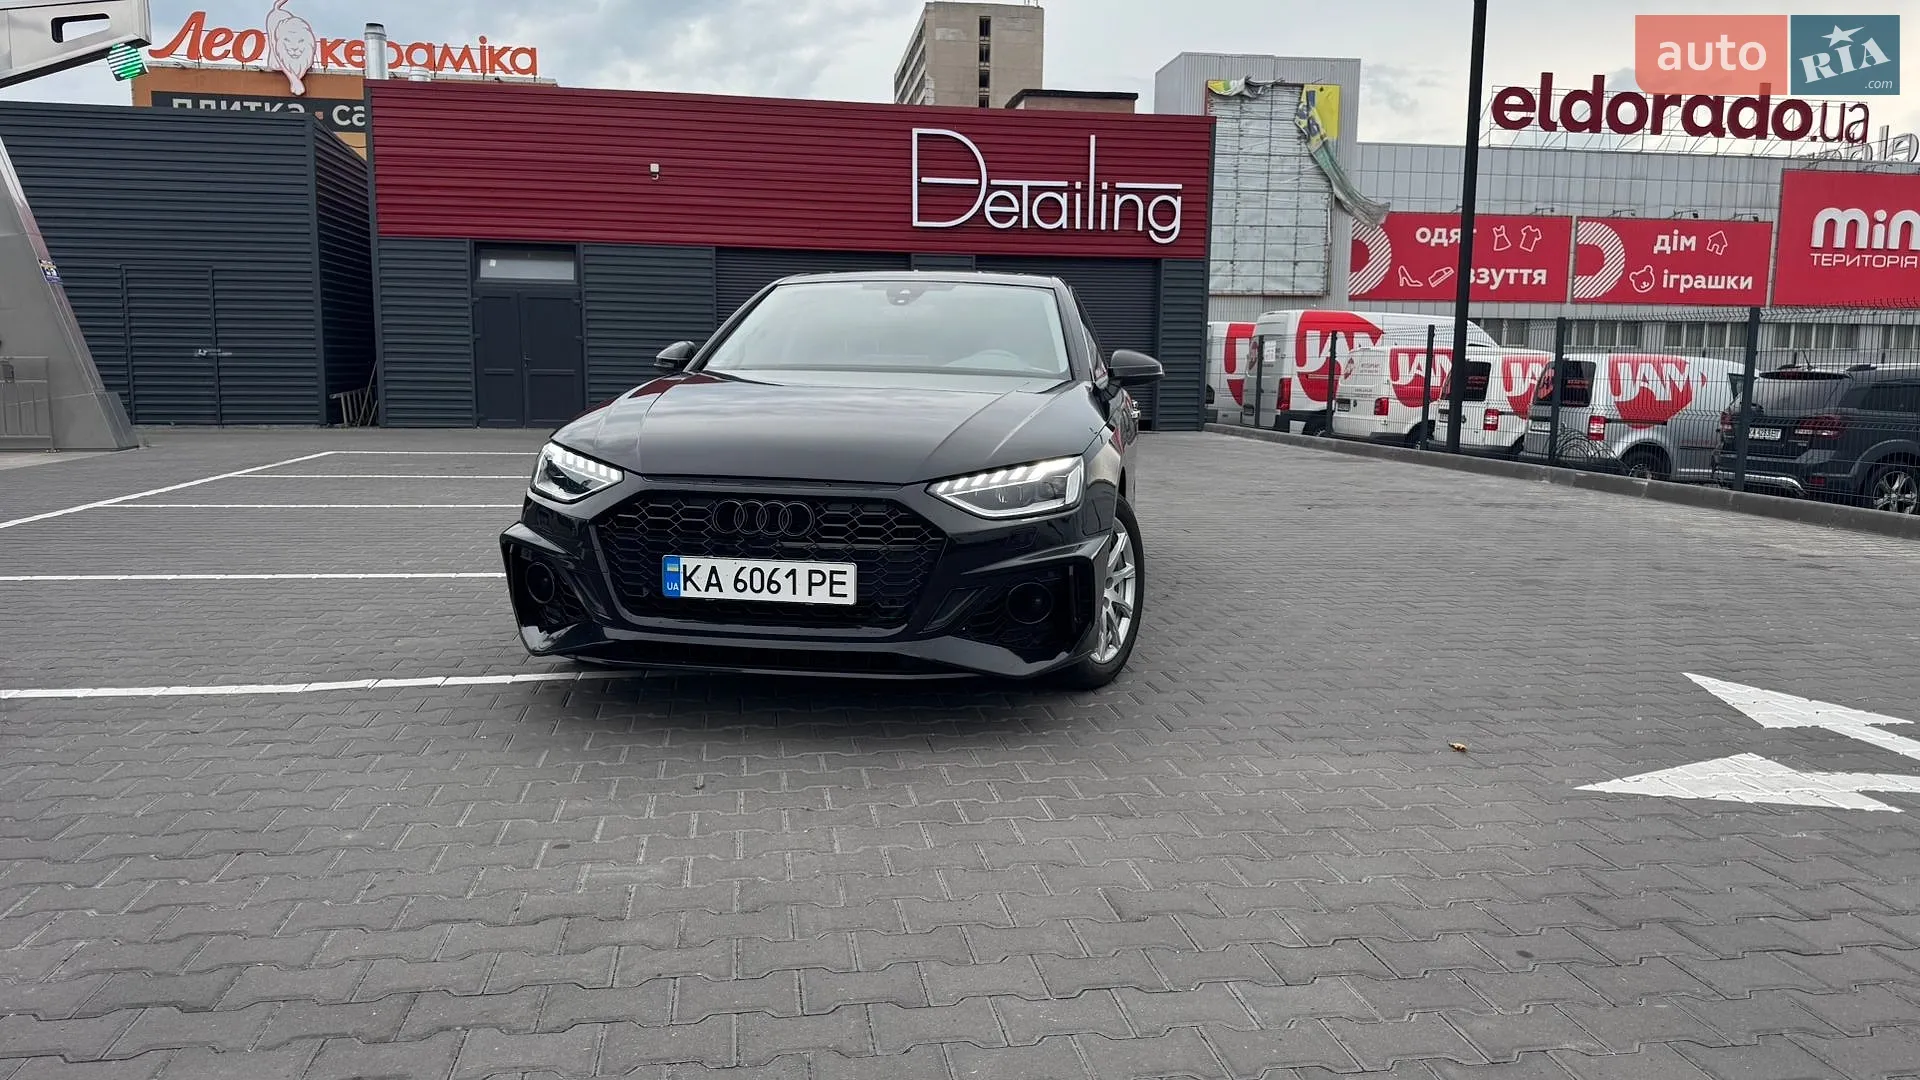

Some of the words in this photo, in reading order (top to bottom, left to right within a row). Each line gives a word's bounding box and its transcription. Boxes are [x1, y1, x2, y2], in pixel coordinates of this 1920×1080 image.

[148, 11, 266, 63] Лео
[1491, 71, 1870, 144] eldorado.ua
[1653, 229, 1697, 255] дім
[1810, 253, 1918, 269] ТЕРИТОРІЯ
[1662, 269, 1753, 294] іграшки
[1612, 362, 1692, 402] JAM
[666, 581, 680, 592] UA
[682, 564, 724, 593] KA
[733, 566, 798, 596] 6061
[807, 569, 848, 598] PE
